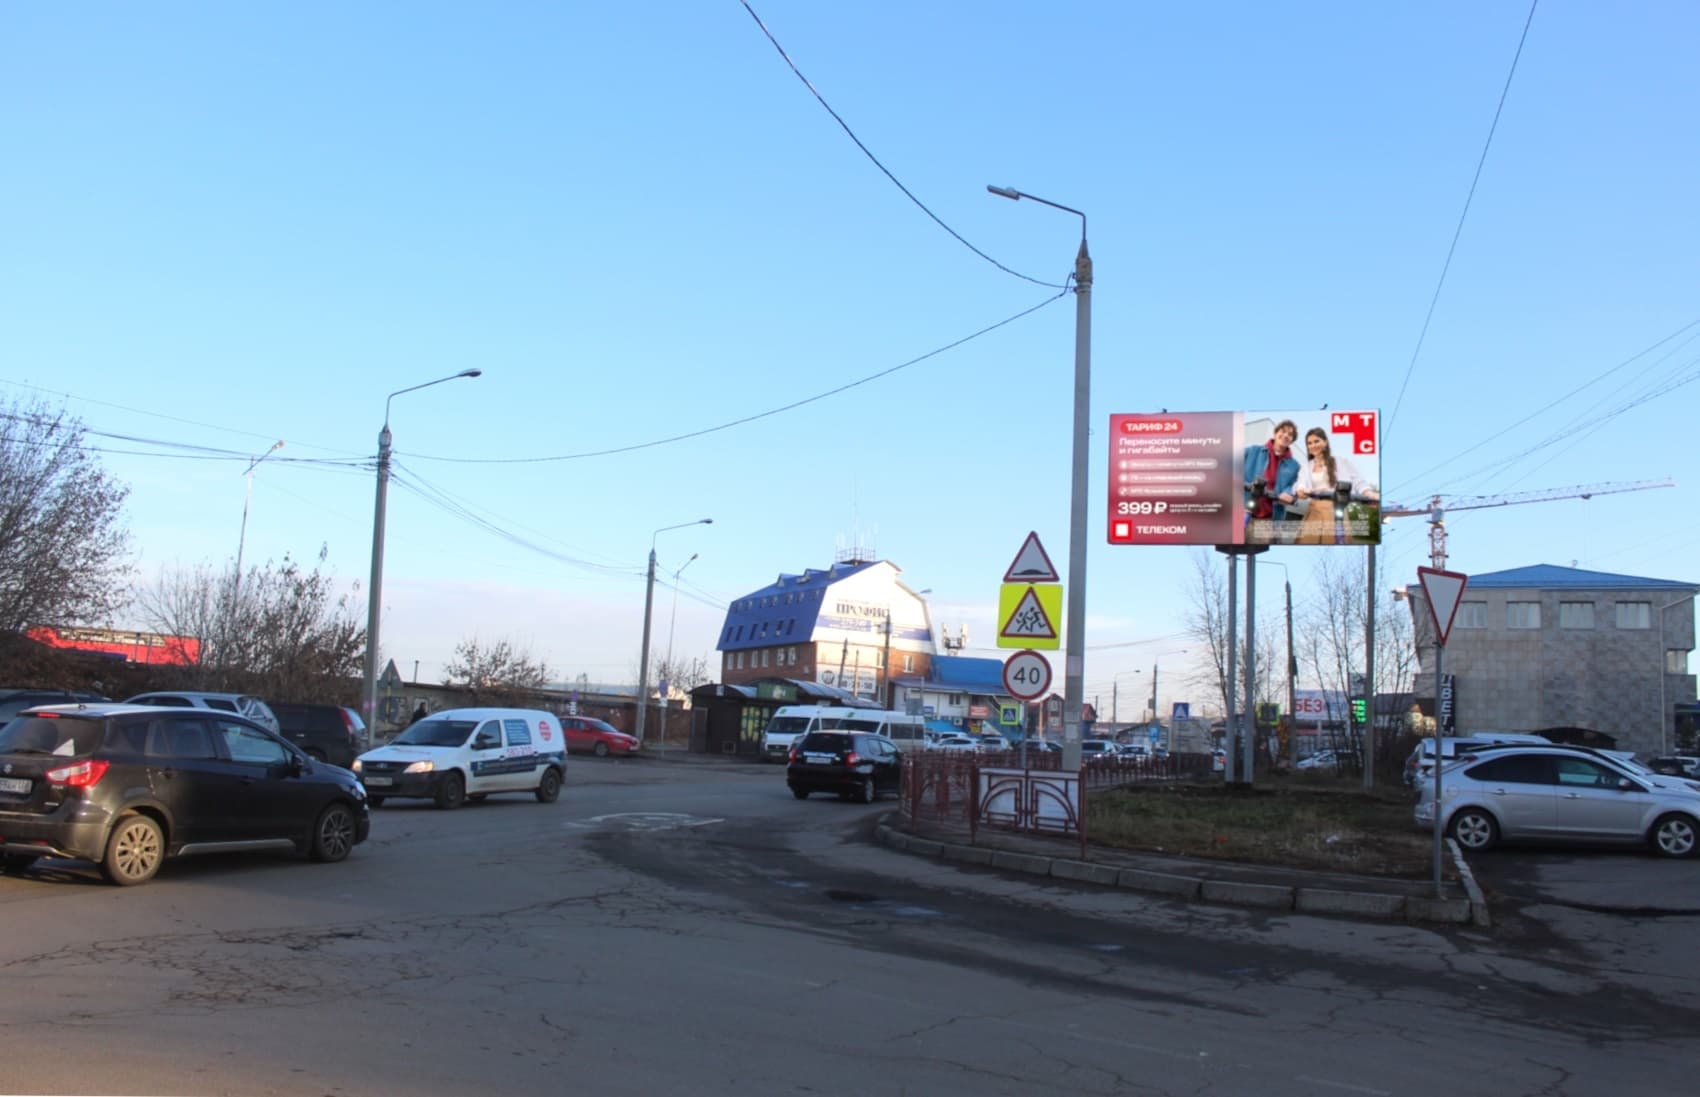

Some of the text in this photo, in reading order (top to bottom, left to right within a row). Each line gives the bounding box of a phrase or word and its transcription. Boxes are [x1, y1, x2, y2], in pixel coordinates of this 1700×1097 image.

[1126, 422, 1178, 431] ТАРИФ 24
[1119, 437, 1221, 447] Переносите минуты
[1127, 445, 1181, 454] гигабайты
[1117, 501, 1152, 515] 399
[1136, 525, 1187, 534] ТЕЛЕКОМ
[1013, 667, 1041, 685] 40
